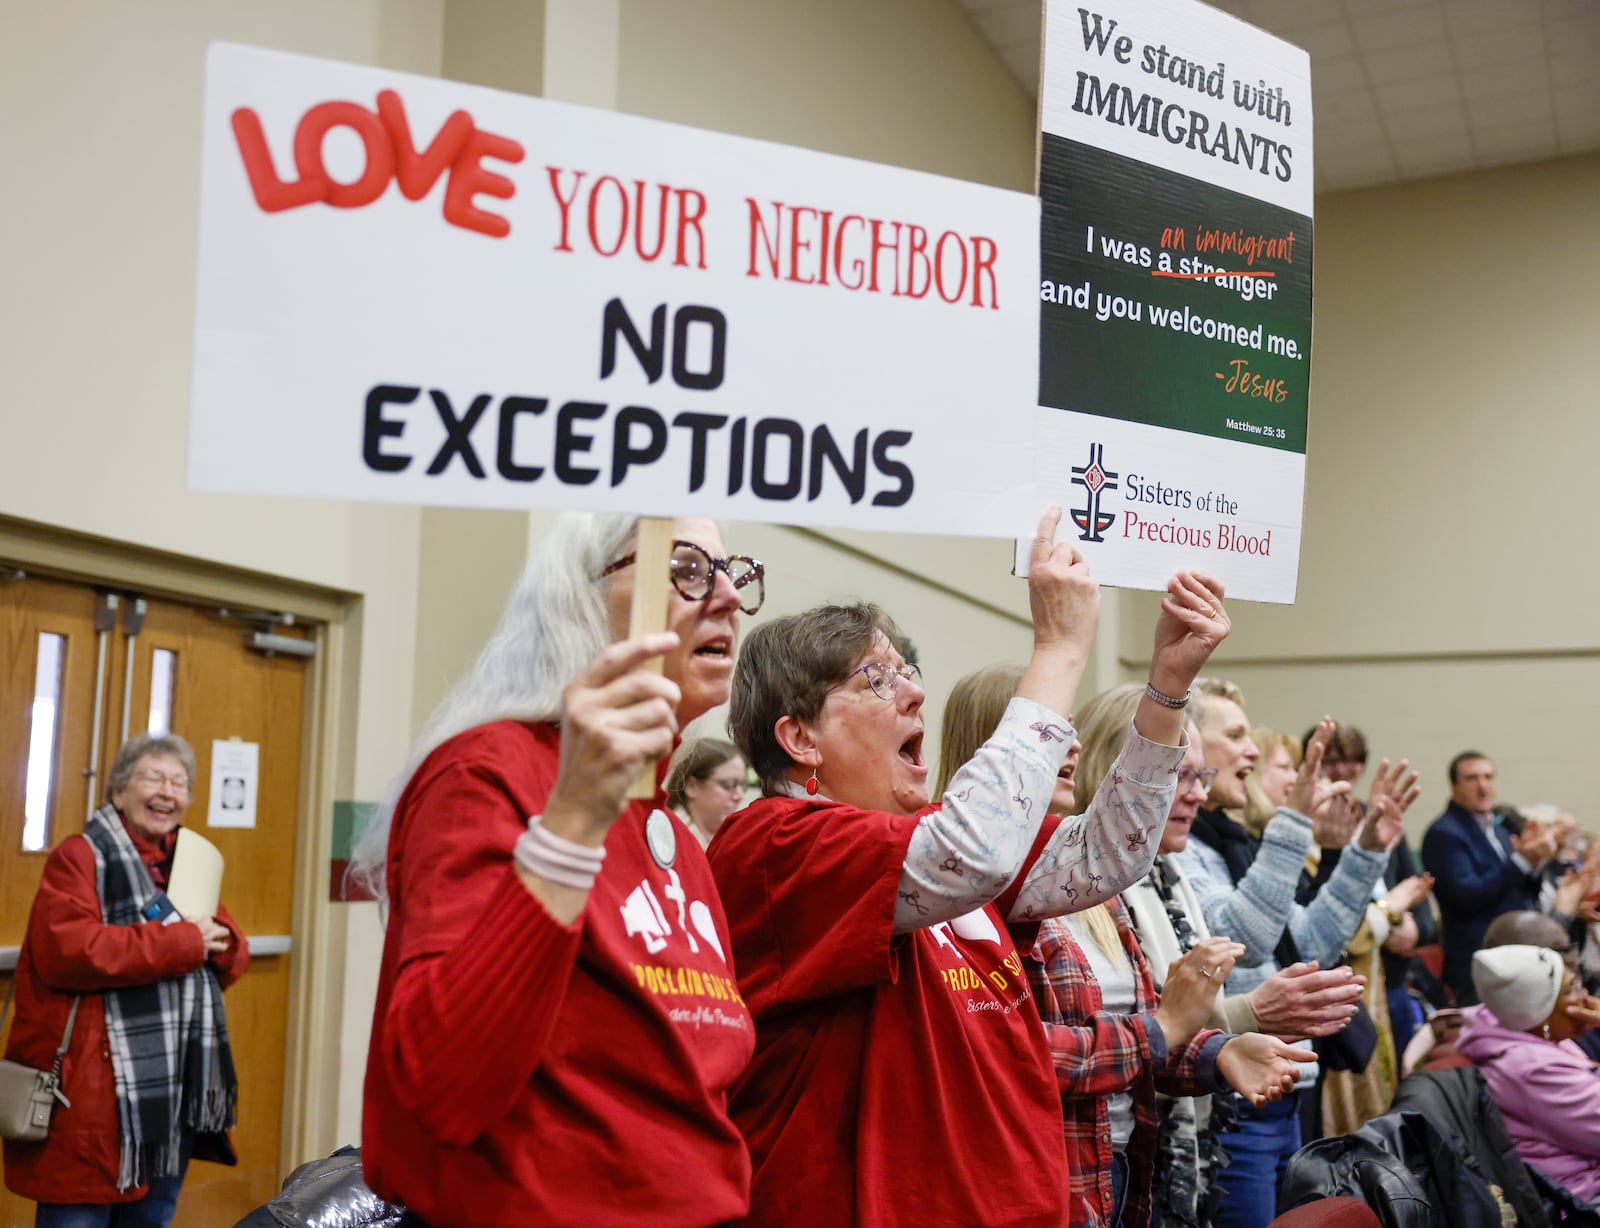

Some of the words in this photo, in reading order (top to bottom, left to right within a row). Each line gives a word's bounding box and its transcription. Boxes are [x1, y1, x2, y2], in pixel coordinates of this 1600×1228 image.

[1077, 8, 1133, 64] We
[1140, 44, 1225, 100] stand
[1233, 79, 1292, 126] with
[1072, 71, 1292, 182] IMMIGRANTS
[231, 89, 526, 239] LOVE
[545, 166, 708, 269] YOUR
[745, 197, 1000, 310] NEIGHBOR
[1086, 226, 1094, 253] I
[1100, 236, 1152, 268] was
[1158, 252, 1173, 273] a
[1179, 256, 1278, 300] stranger
[1160, 227, 1185, 250] an
[1196, 225, 1296, 266] immigrant
[600, 297, 728, 391] NO
[1040, 279, 1090, 310] and
[1095, 292, 1142, 321] you
[1148, 305, 1263, 350] welcomed
[1267, 334, 1303, 360] me.
[362, 384, 915, 508] EXCEPTIONS
[1226, 418, 1262, 434] Matthew
[1276, 428, 1286, 439] 35
[1122, 510, 1211, 549] Precious
[1217, 523, 1271, 556] Blood
[1125, 473, 1192, 509] Sisters
[1196, 491, 1213, 512] of
[1215, 493, 1239, 516] the
[967, 998, 1000, 1013] Sisters
